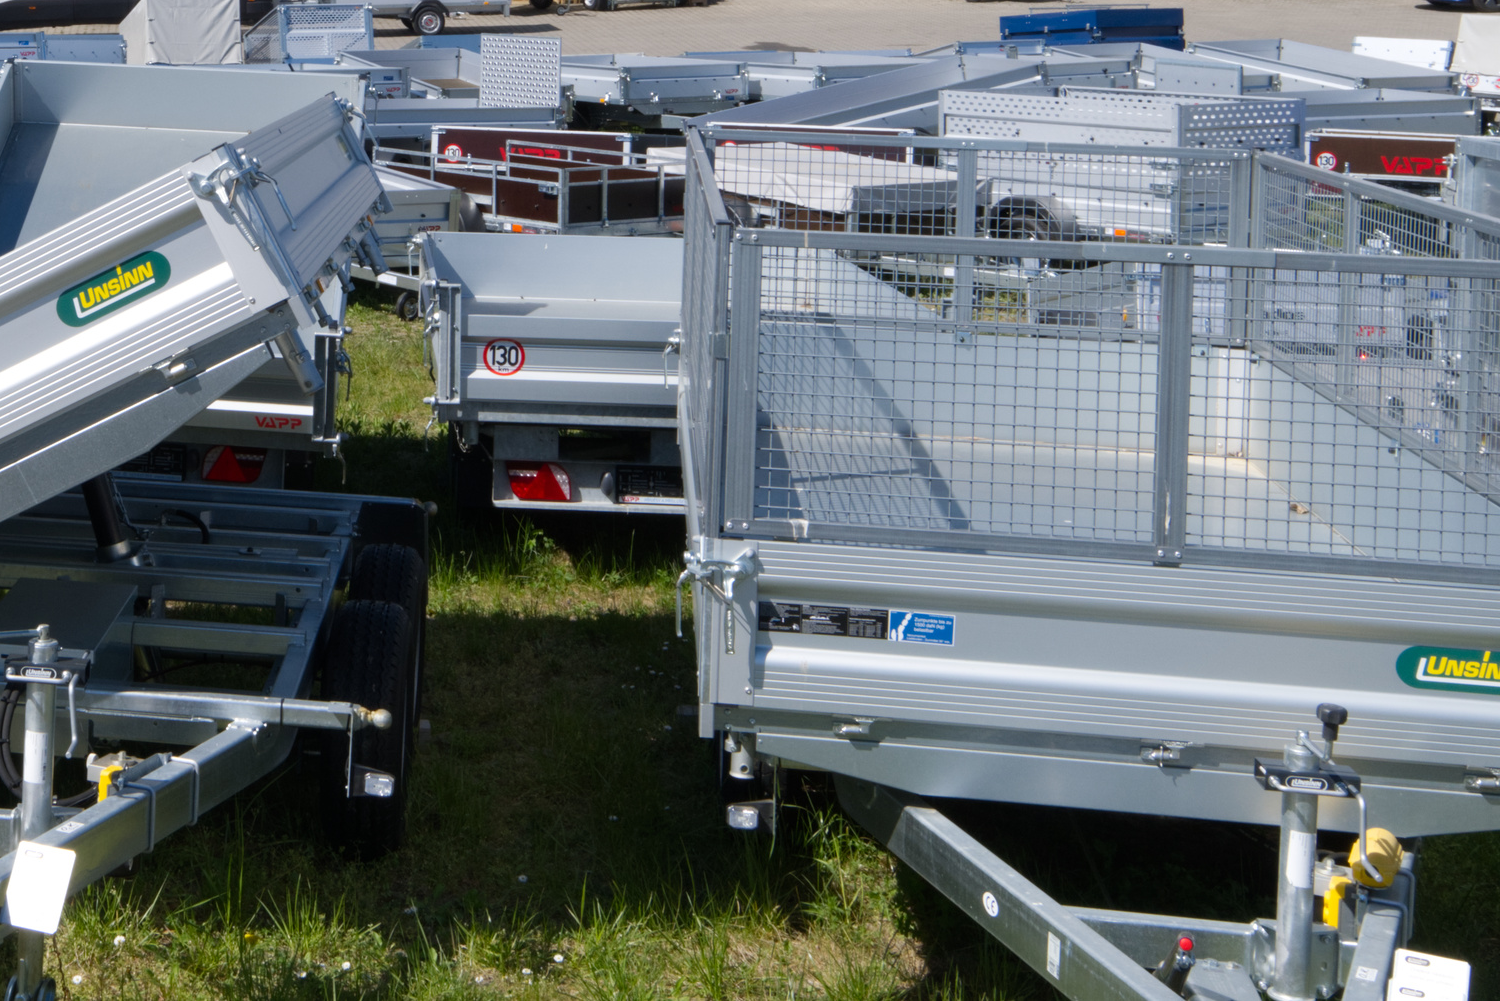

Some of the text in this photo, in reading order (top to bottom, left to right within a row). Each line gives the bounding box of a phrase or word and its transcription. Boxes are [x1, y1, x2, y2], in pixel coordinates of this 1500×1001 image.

[1318, 155, 1335, 166] 130
[489, 345, 519, 366] 130
[255, 415, 302, 430] VAPP
